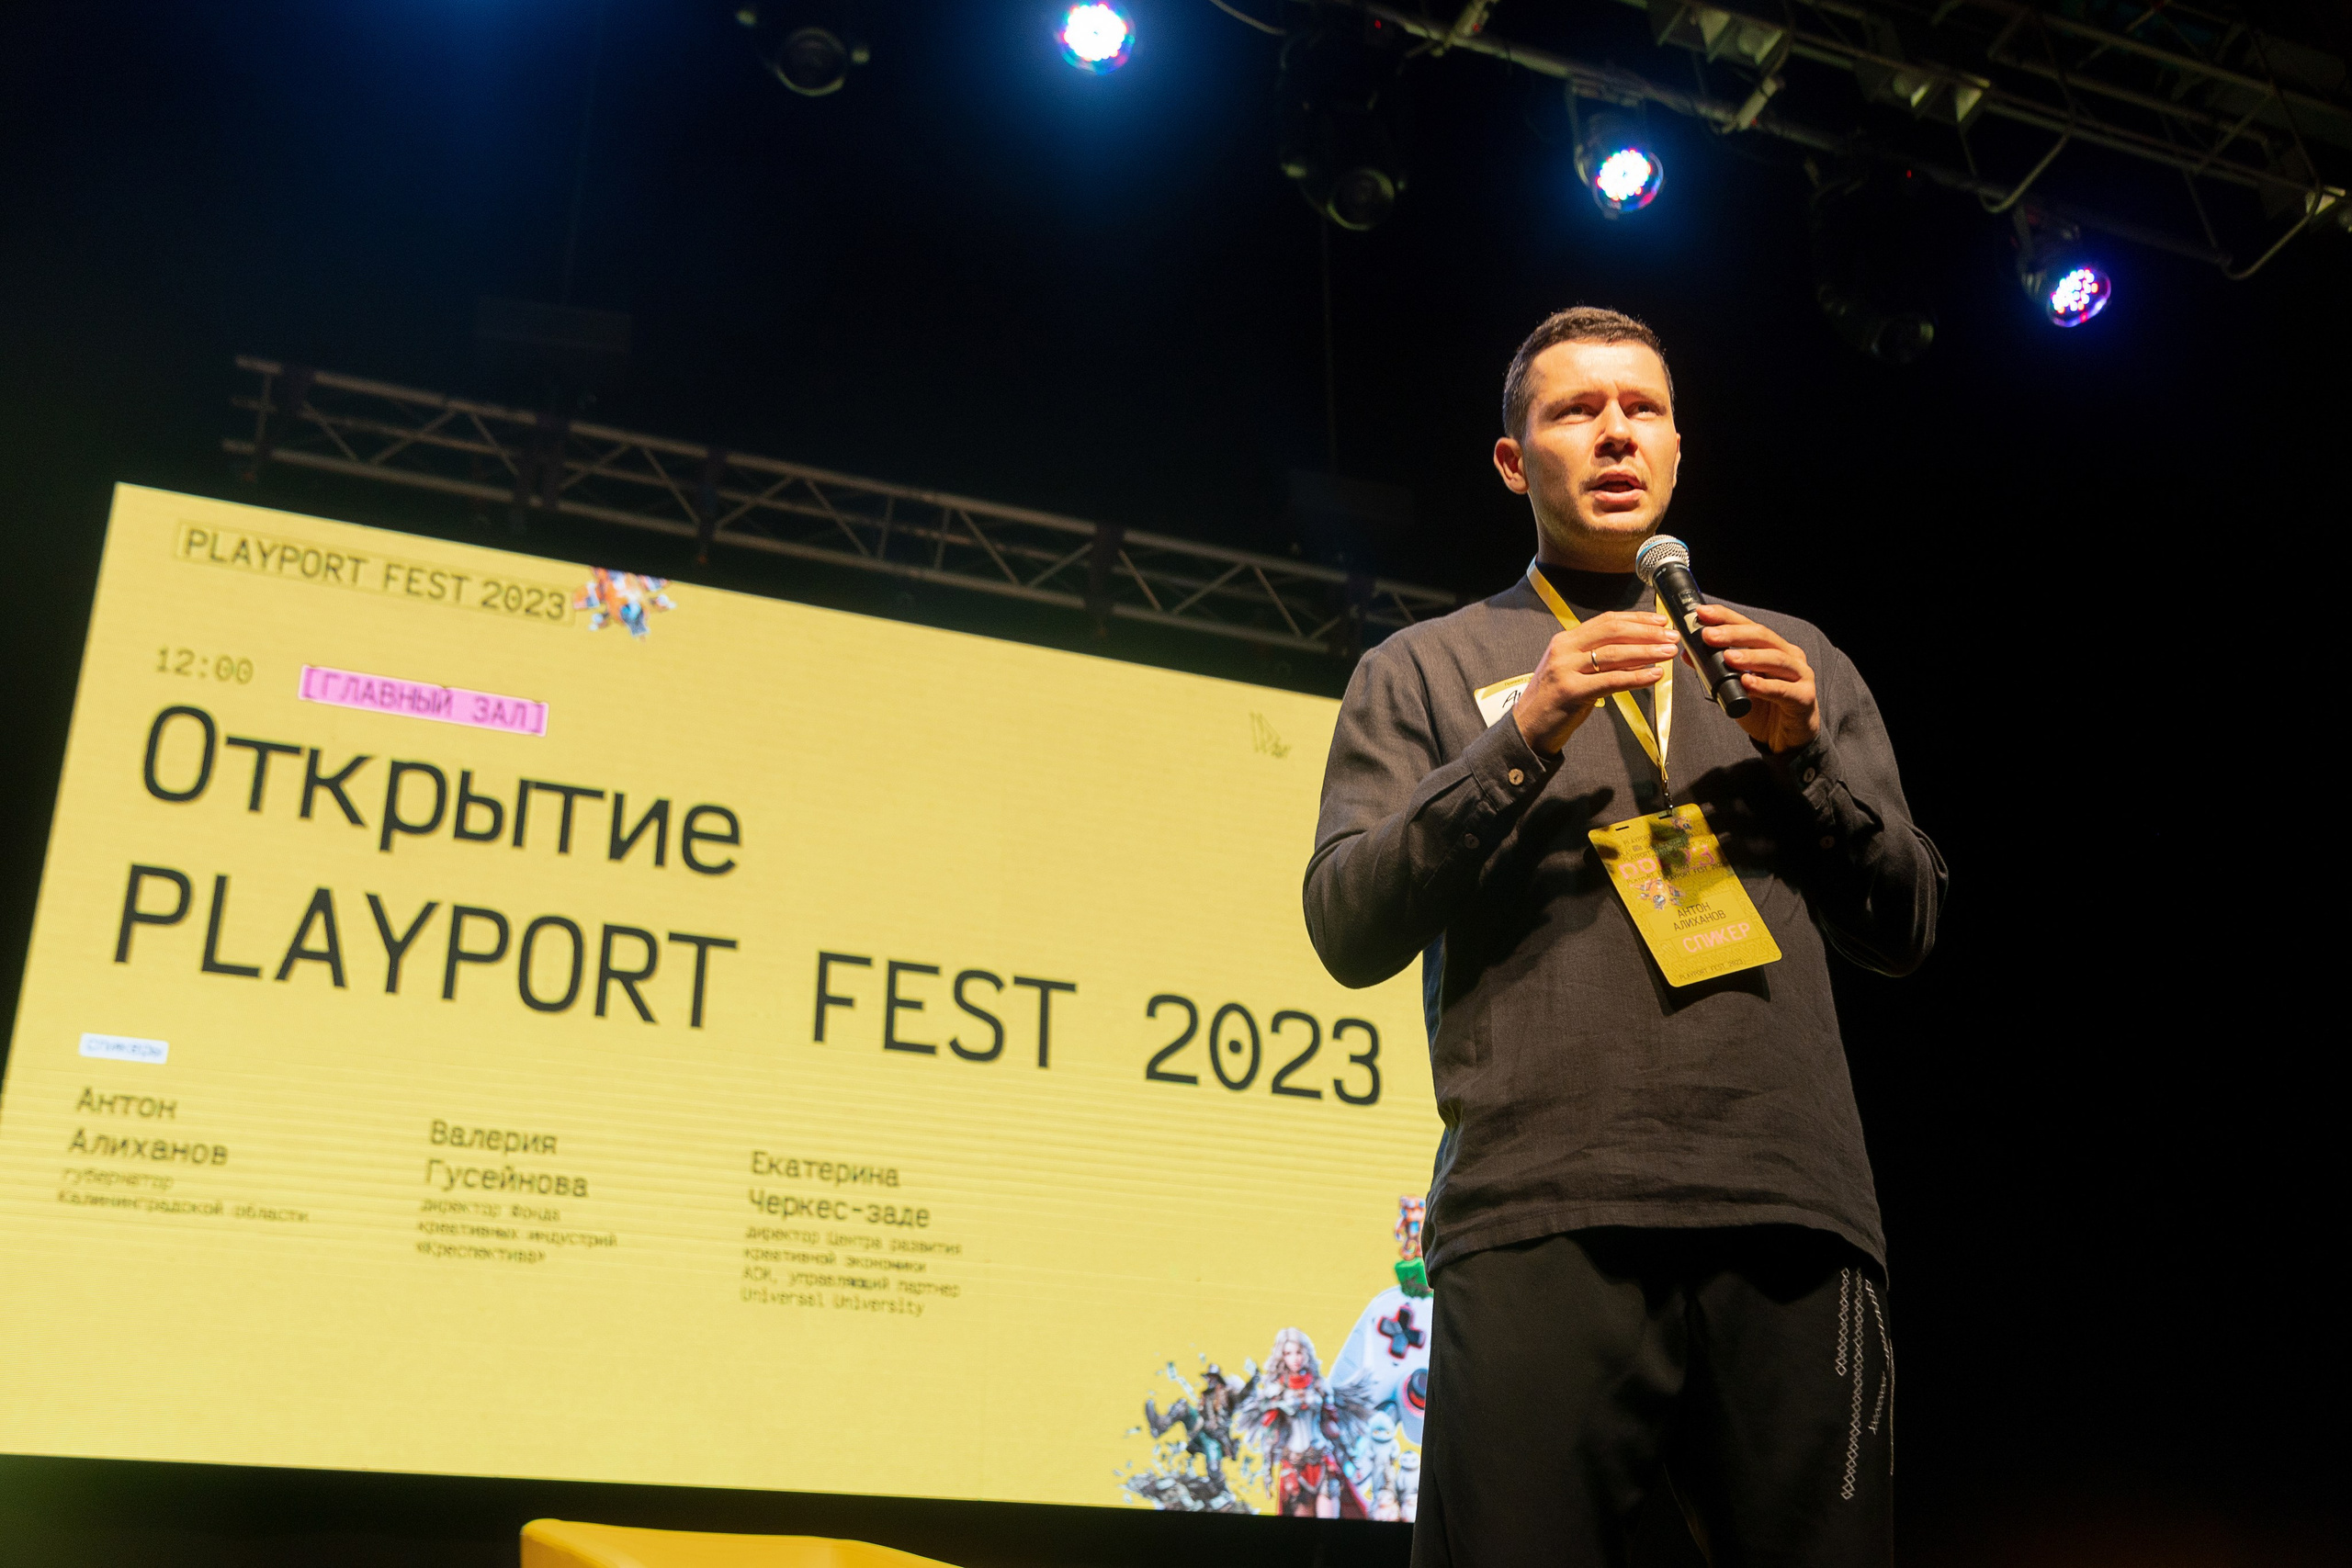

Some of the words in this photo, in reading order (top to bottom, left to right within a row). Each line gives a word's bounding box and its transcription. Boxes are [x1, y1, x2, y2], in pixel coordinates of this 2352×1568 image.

[184, 528, 368, 586] PLAYPORT
[382, 562, 471, 604] FEST
[480, 580, 566, 620] 2023
[156, 647, 254, 684] 12:00
[143, 705, 742, 876] Открытие
[1673, 909, 1726, 932] АЛИХАНОВ
[1677, 902, 1712, 919] АНТОН
[1682, 921, 1751, 953] СПИКЕР
[113, 863, 740, 1029] PLAYPORT
[812, 950, 1078, 1069] FEST
[1144, 992, 1384, 1108] 2023
[76, 1086, 177, 1119] Антон
[68, 1127, 230, 1167] Алиханов
[430, 1118, 559, 1155] Валерия
[424, 1158, 589, 1198] Гусейнова
[751, 1151, 900, 1188] Екатерина
[748, 1188, 931, 1228] Черкес-заде
[741, 1286, 825, 1308] Universal
[833, 1292, 926, 1318] University
